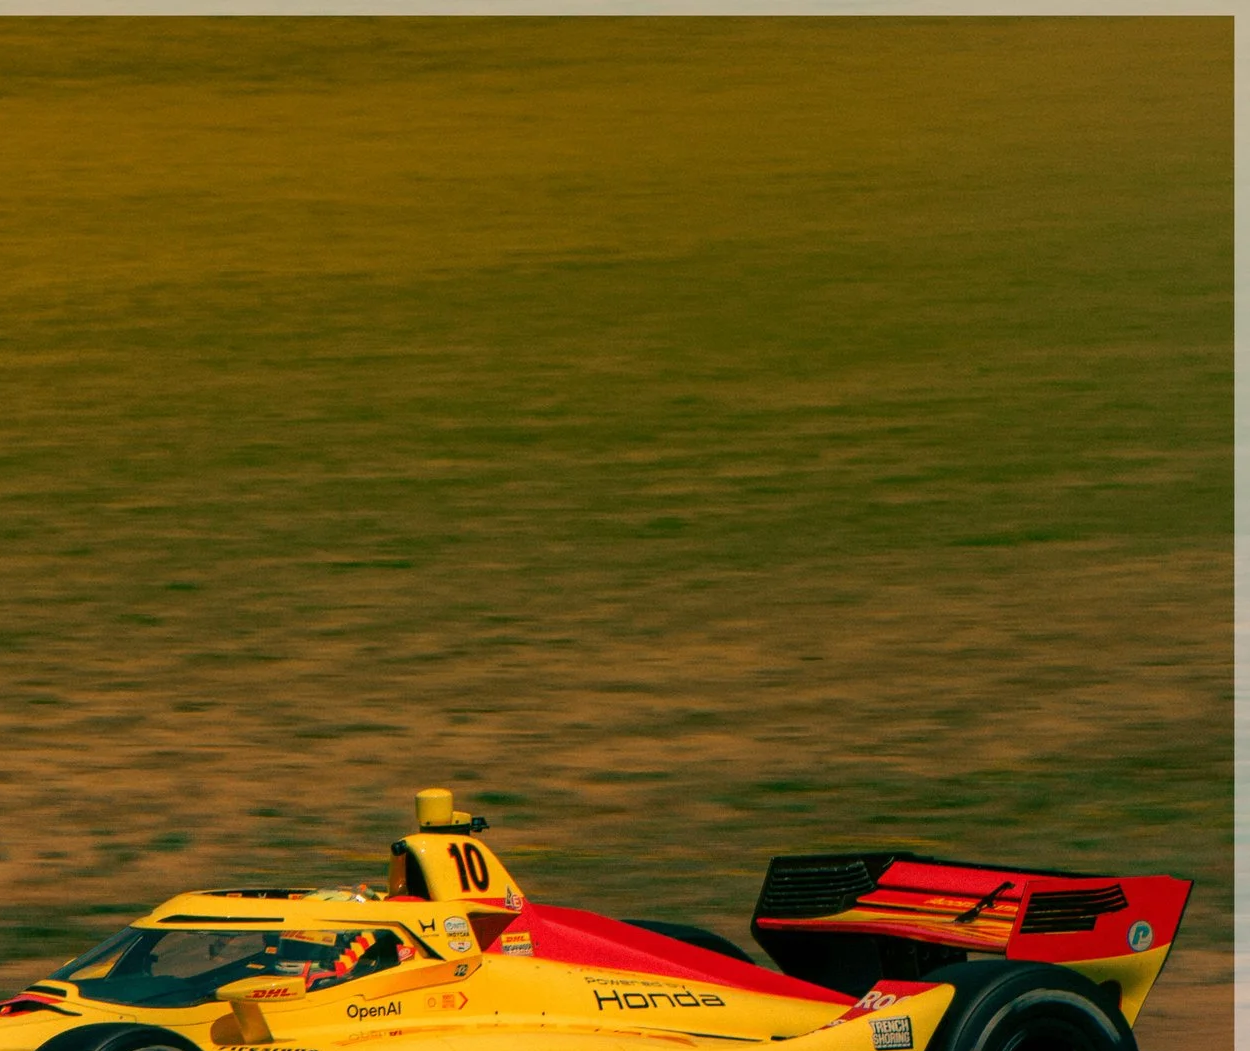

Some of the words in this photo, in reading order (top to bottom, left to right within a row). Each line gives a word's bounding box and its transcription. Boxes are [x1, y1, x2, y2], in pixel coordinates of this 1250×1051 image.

[447, 842, 490, 893] 10
[252, 987, 291, 999] DHL
[593, 989, 726, 1011] Honda
[346, 1001, 402, 1021] OpenAI
[870, 1019, 909, 1033] TRENCH
[872, 1032, 911, 1045] SHORING
